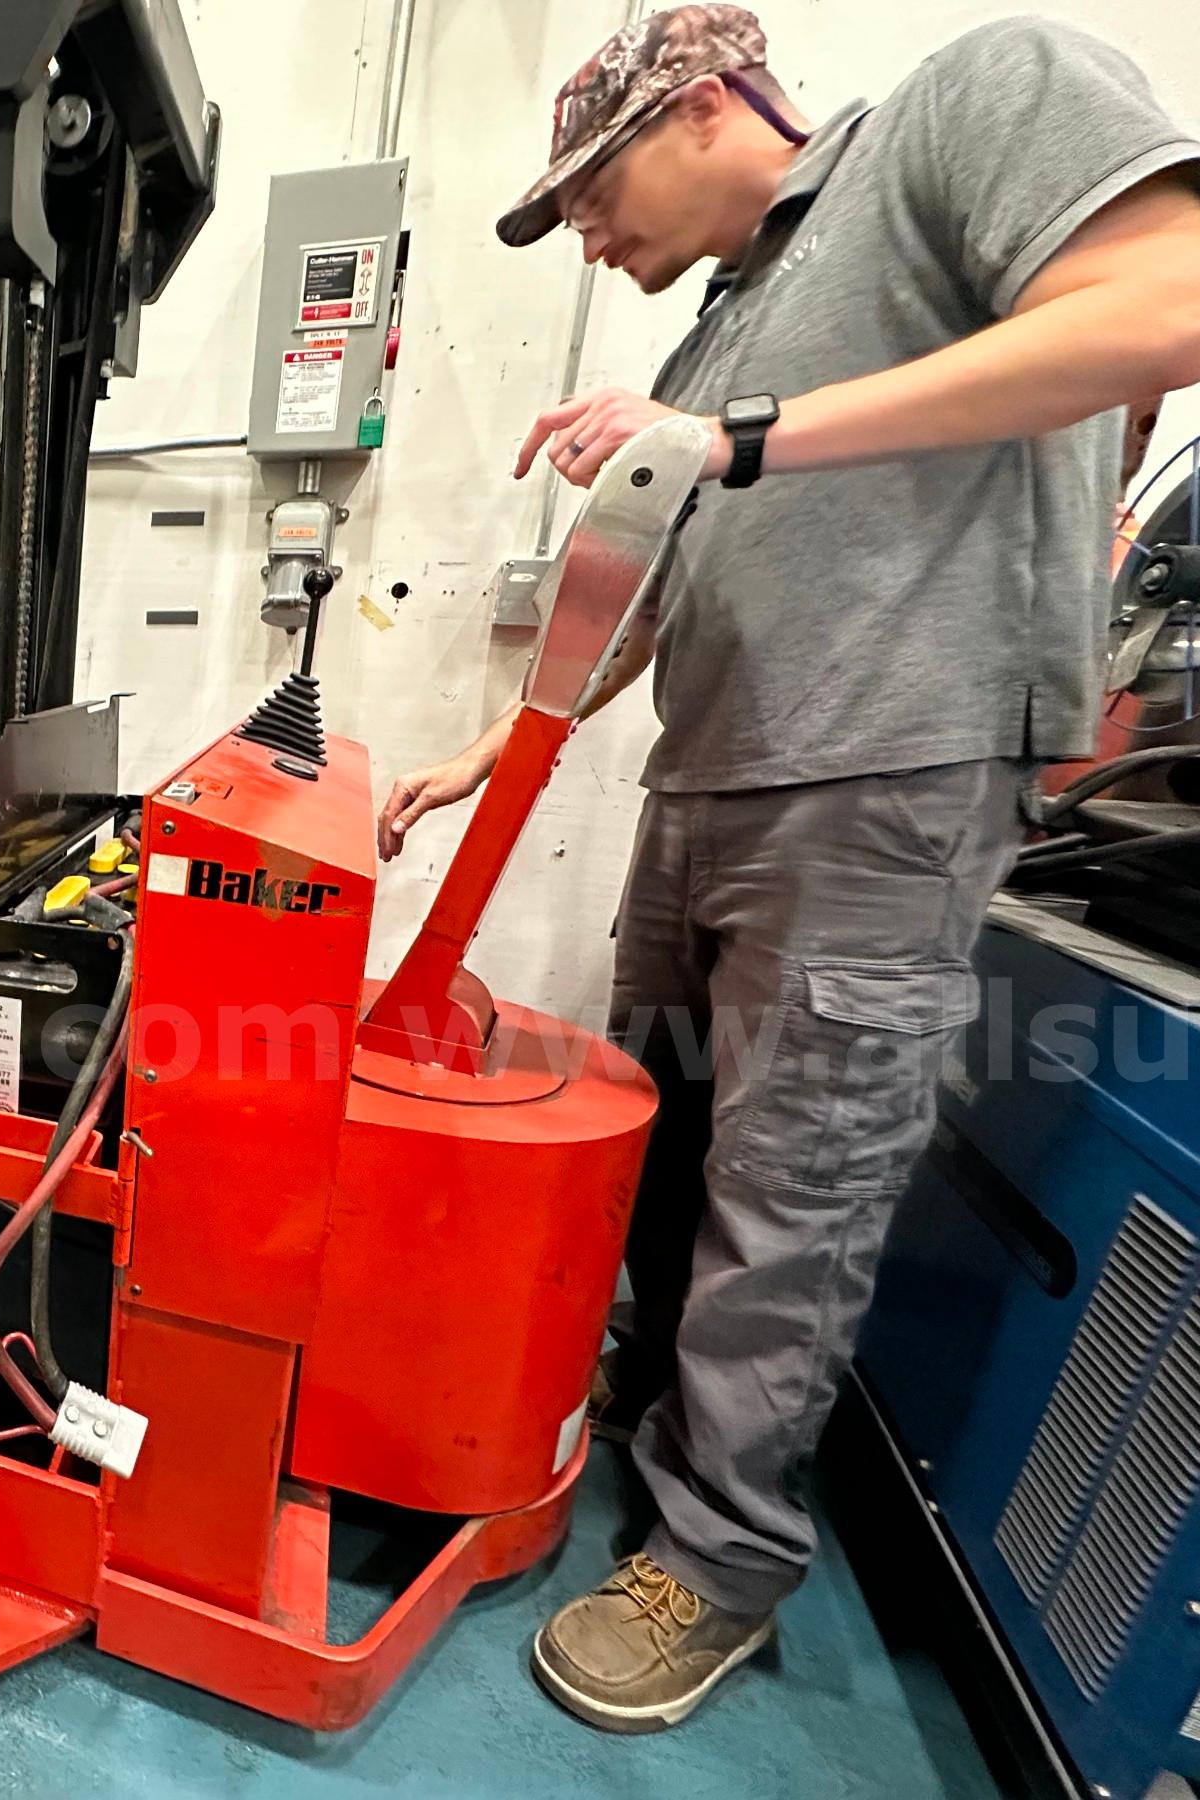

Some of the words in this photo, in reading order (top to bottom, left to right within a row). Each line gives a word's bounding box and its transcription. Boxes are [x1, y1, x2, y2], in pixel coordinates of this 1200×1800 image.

[362, 248, 374, 265] ON
[355, 301, 369, 318] OFF
[303, 352, 333, 361] DANGER
[187, 858, 341, 915] Baker
